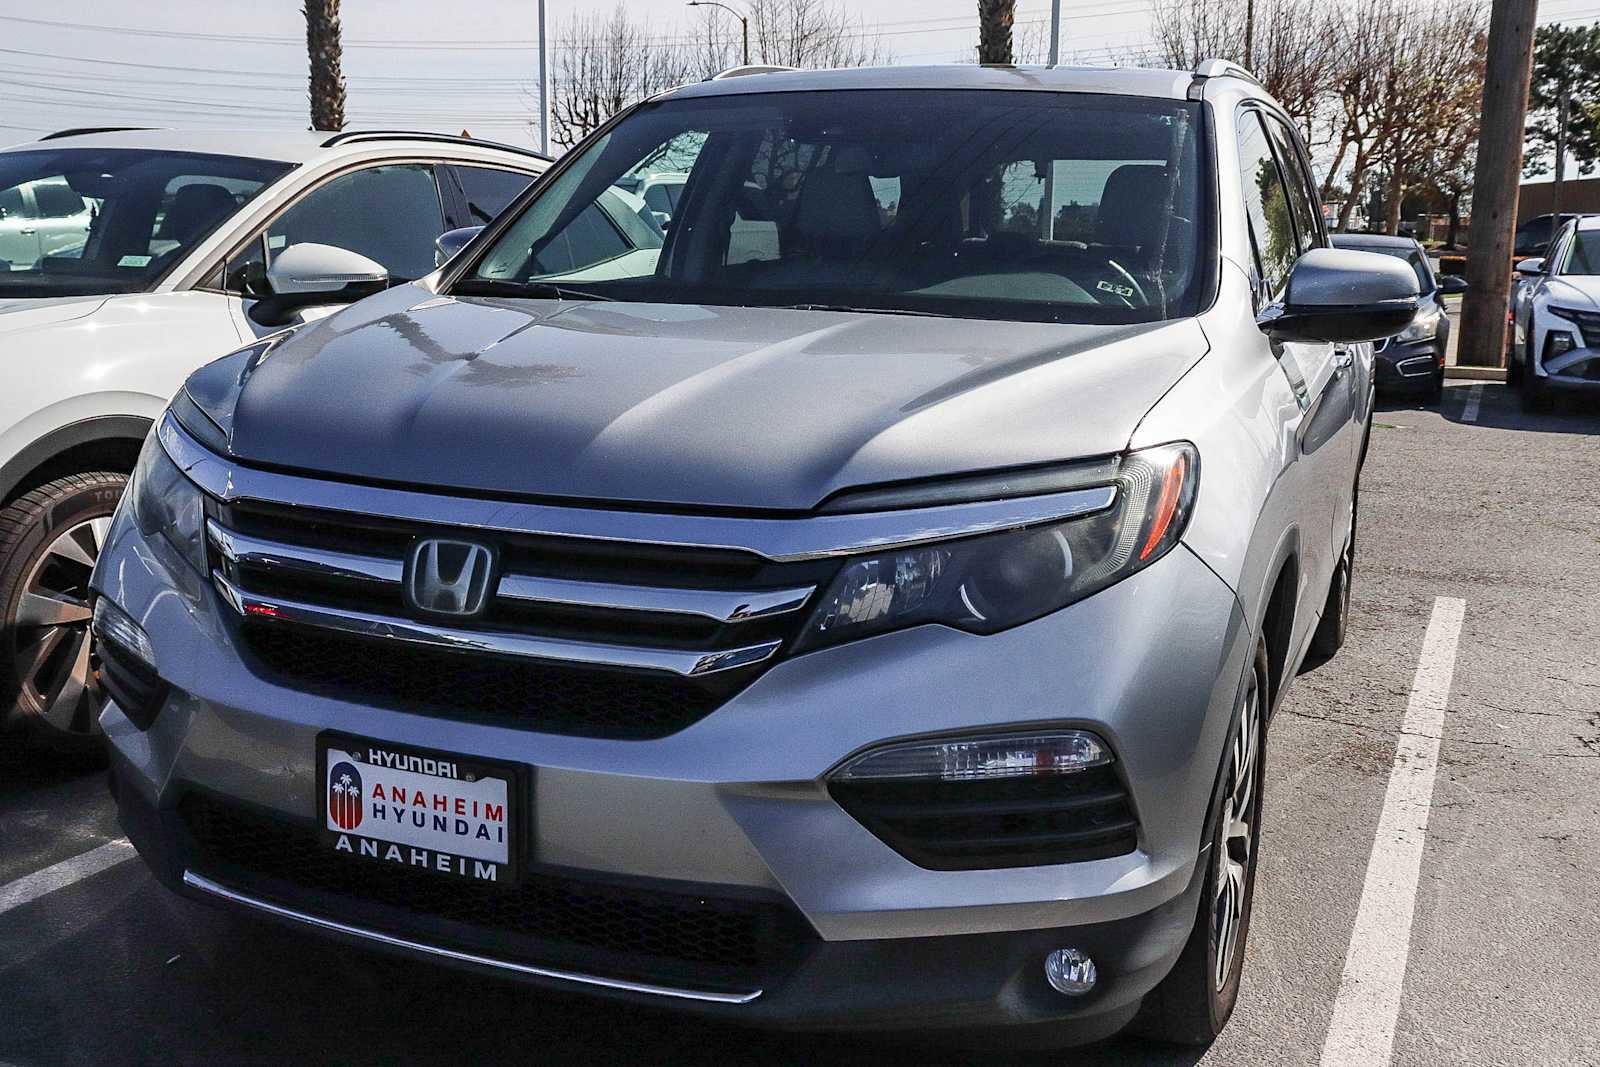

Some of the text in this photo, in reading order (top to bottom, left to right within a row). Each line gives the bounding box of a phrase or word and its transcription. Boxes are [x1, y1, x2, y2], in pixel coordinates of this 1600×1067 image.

[368, 748, 457, 779] HYUNDAI
[372, 783, 503, 822] ANAHEIM
[373, 802, 503, 843] HYUNDAI
[335, 834, 497, 881] ANAHEIM
